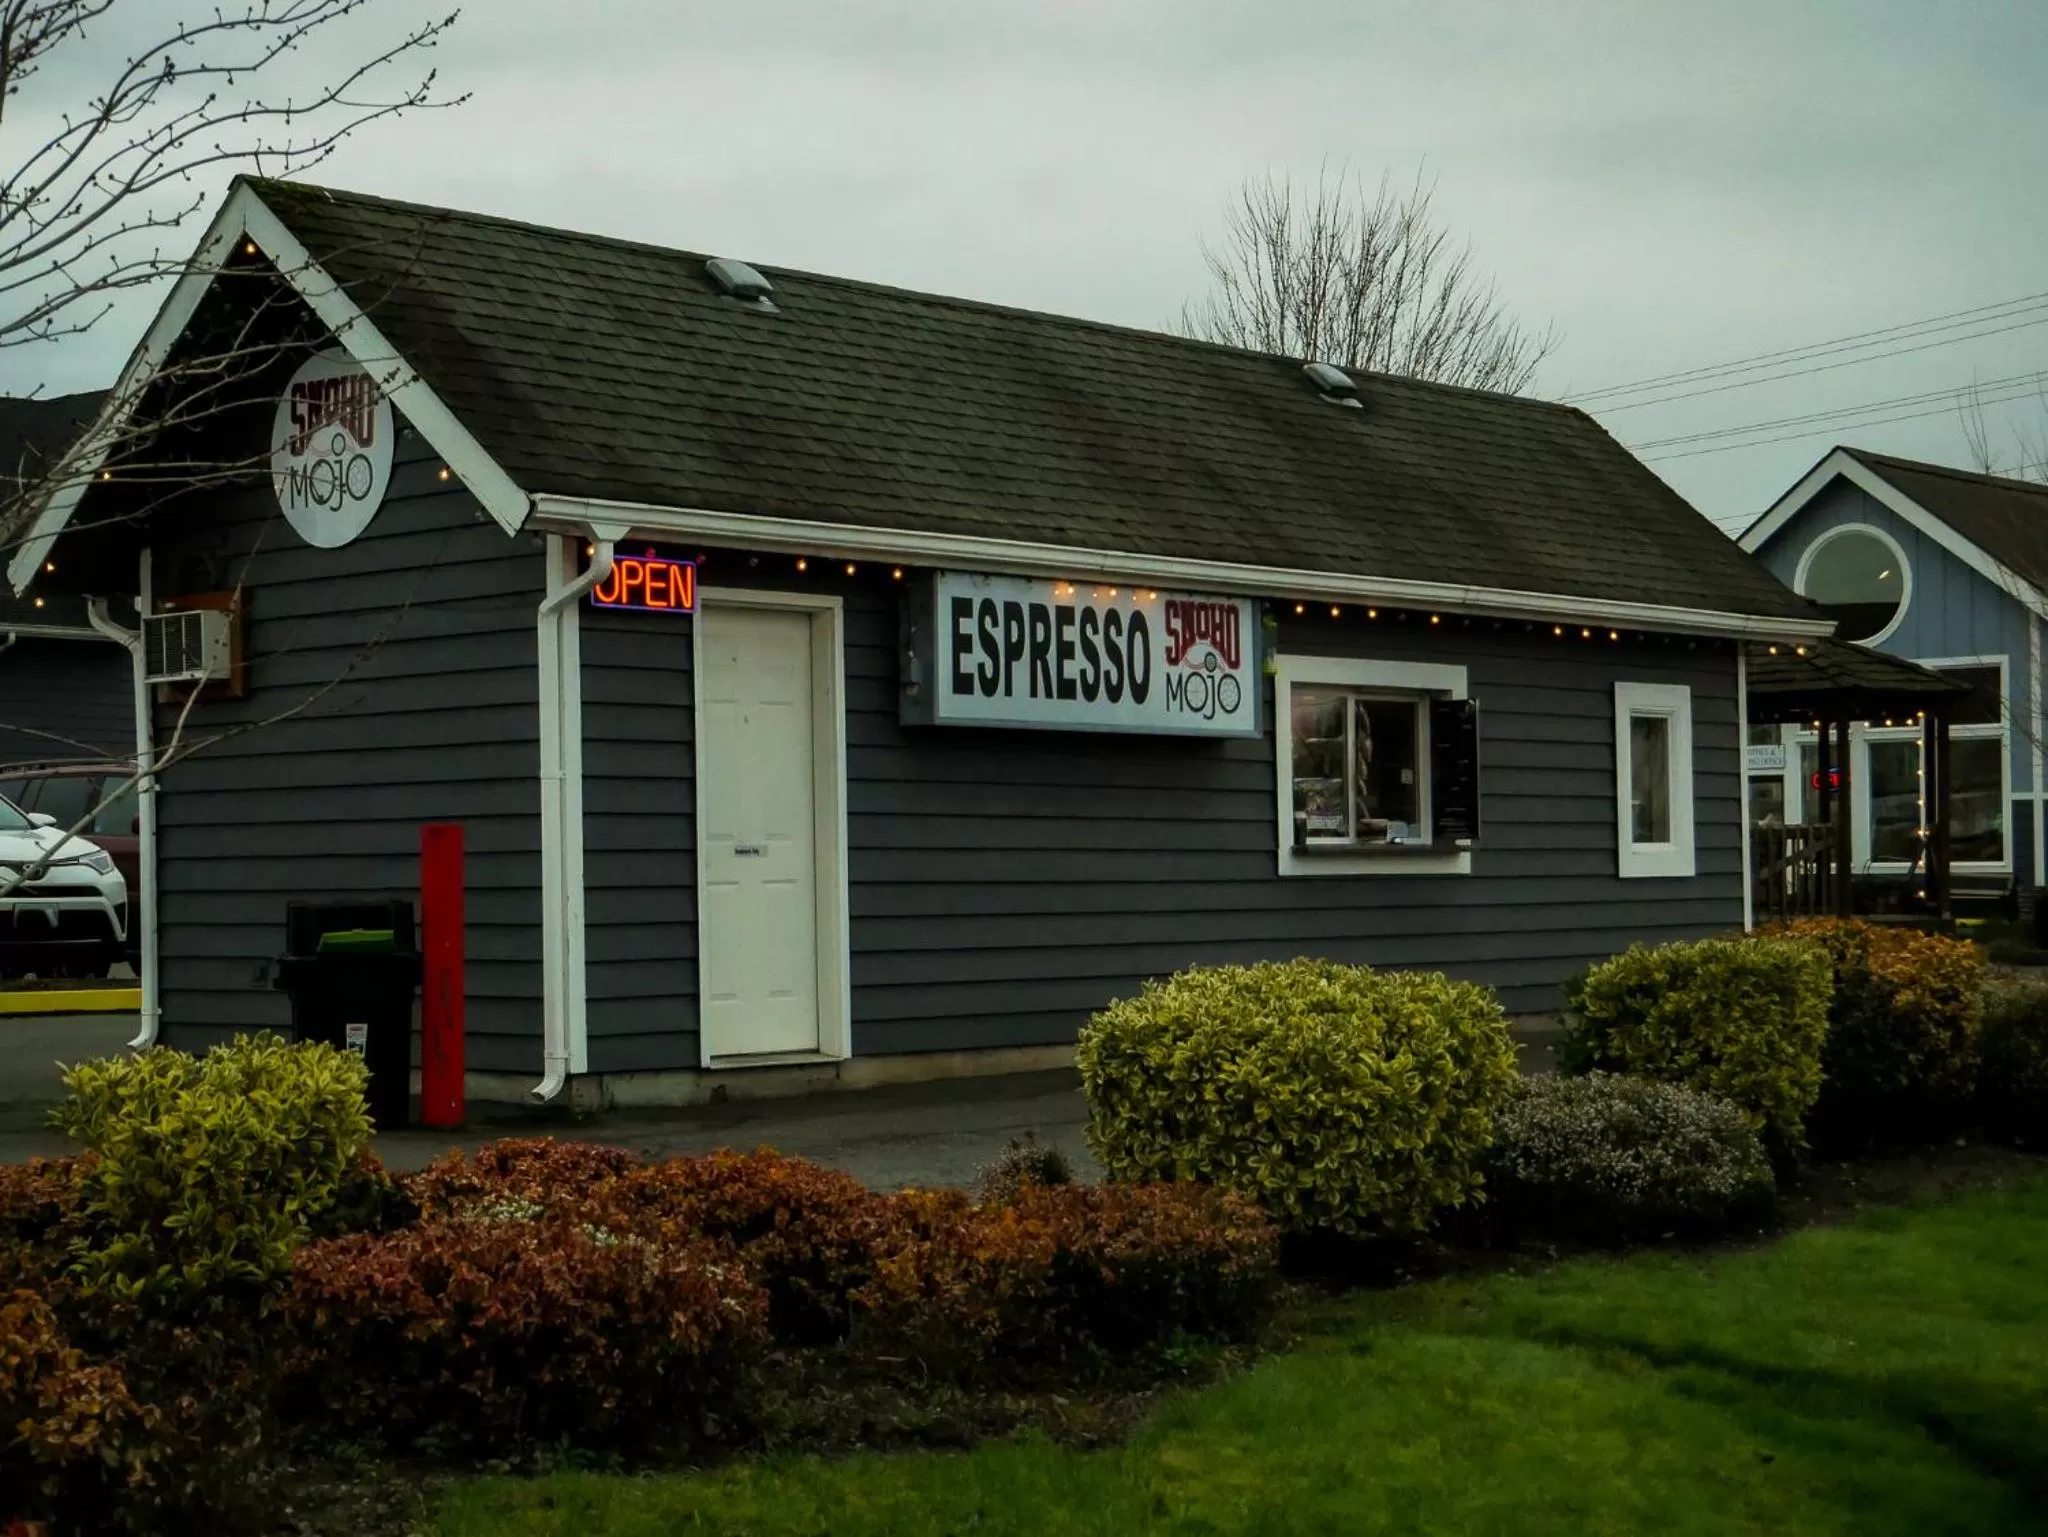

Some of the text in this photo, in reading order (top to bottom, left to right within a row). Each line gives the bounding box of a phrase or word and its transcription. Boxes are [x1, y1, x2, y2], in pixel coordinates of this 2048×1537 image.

[595, 560, 692, 608] OPEN
[951, 596, 1151, 705] ESPRESSO
[1164, 600, 1241, 669] SNOHO
